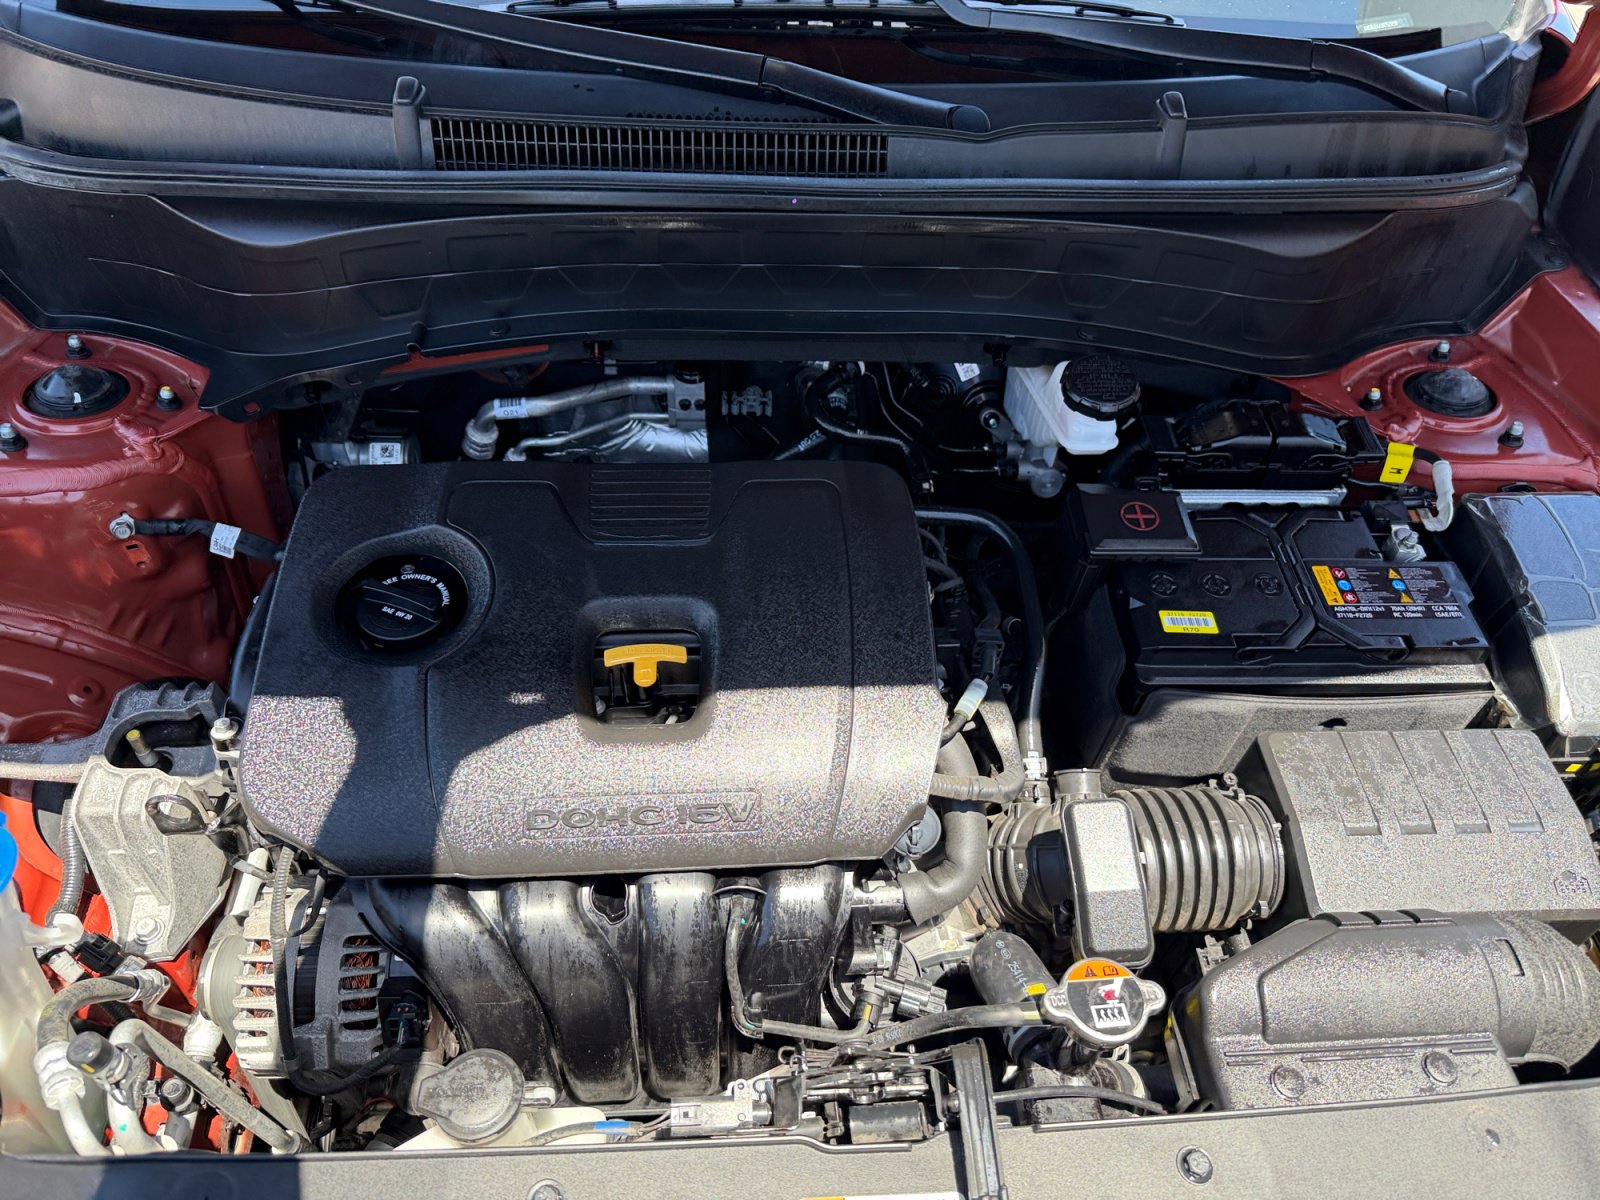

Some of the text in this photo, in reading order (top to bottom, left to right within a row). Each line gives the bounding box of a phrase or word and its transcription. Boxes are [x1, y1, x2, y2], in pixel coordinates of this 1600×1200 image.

[382, 574, 450, 607] SEE OWNER'S MANUAL
[382, 606, 395, 614] SAE
[526, 802, 755, 830] DOHC 16V
